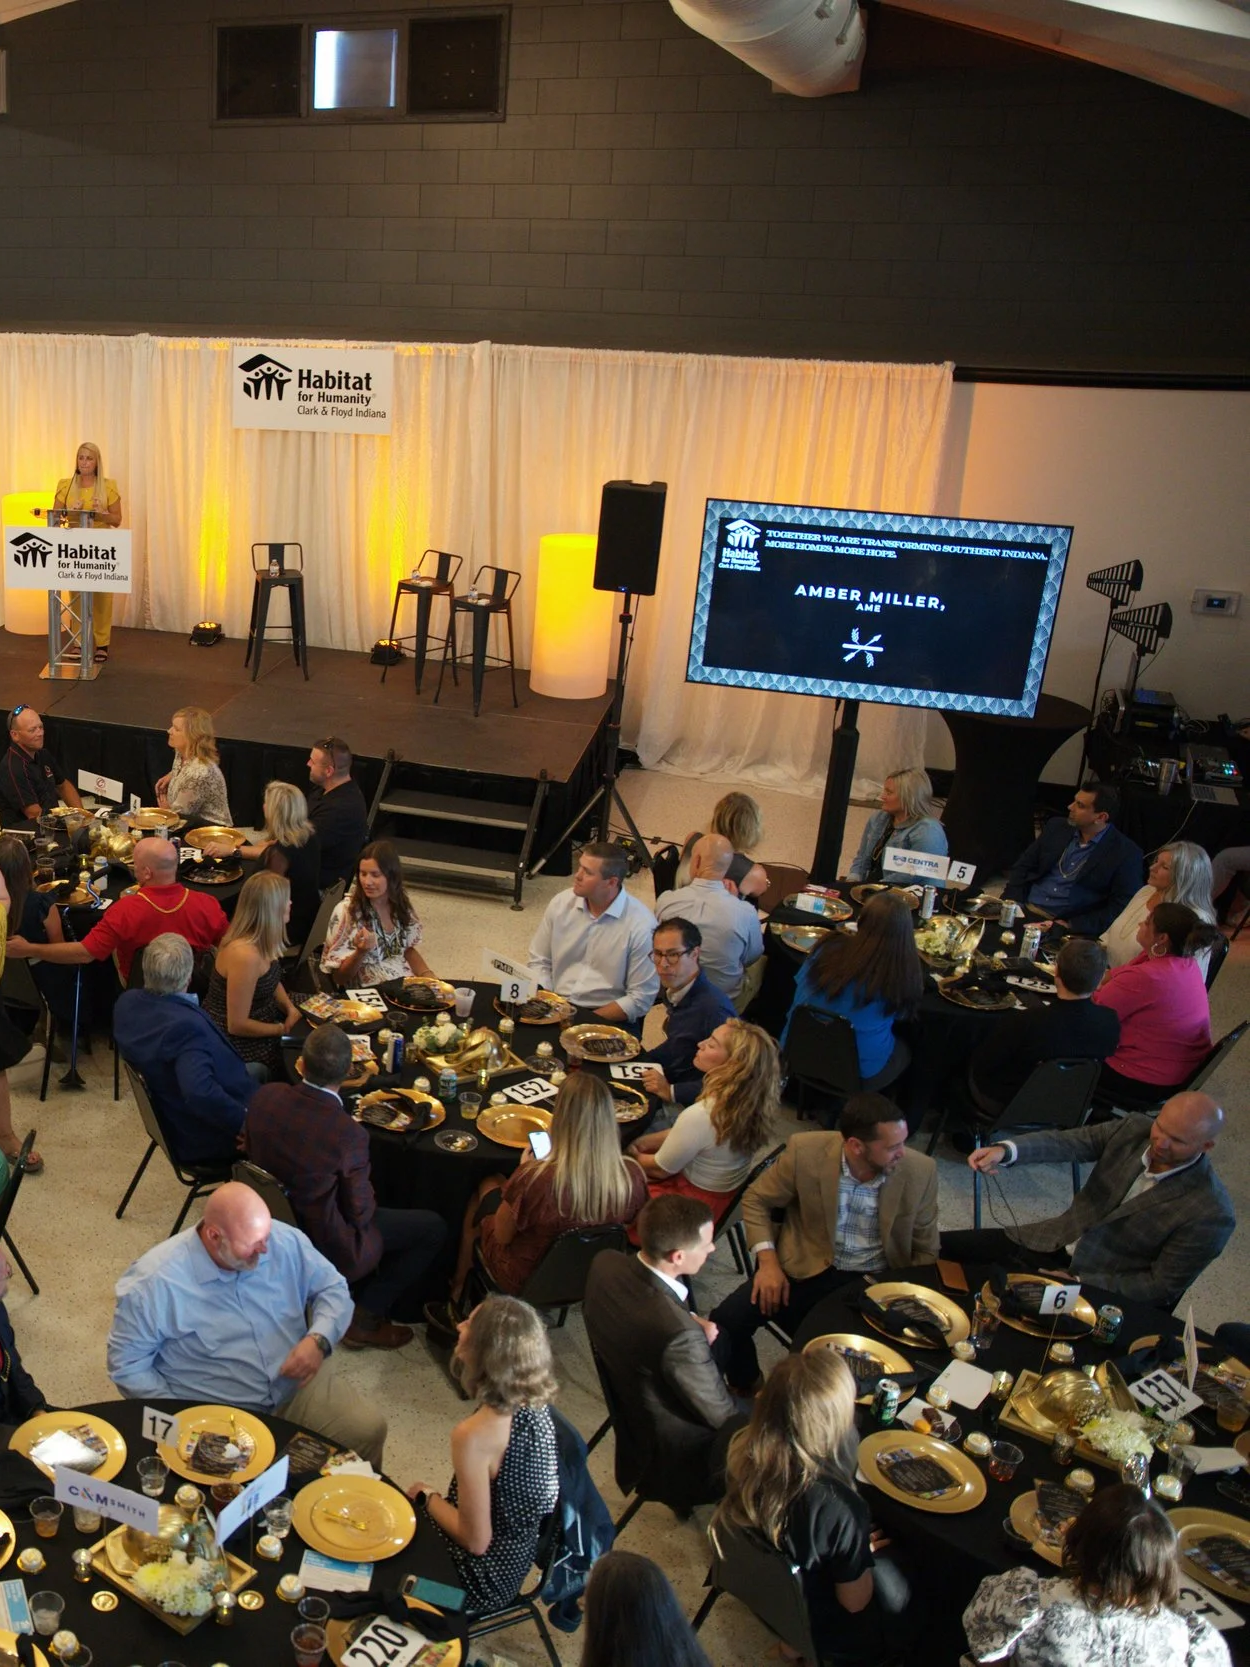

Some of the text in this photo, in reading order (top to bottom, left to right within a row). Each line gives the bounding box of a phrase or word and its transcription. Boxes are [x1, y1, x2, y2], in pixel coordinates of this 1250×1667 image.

[297, 368, 372, 391] Habitat
[297, 390, 314, 402] for
[297, 405, 387, 419] Clark & Floyd Indiana
[57, 543, 117, 560] Habitat
[722, 547, 759, 560] Habitat
[764, 540, 898, 559] MORE HOMES. MORE HOPE.
[766, 529, 1049, 561] TOGETHER WE ARE TRANSFORMING SOUTHERN INDIANA.
[57, 559, 71, 569] for
[57, 570, 76, 579] Clark
[84, 571, 102, 581] Floyd
[103, 573, 129, 581] Indiana
[794, 584, 946, 612] AMBER MILLER,
[855, 603, 882, 613] AME
[907, 858, 939, 869] CENTRA
[956, 865, 968, 879] 5
[510, 983, 520, 999] 8
[618, 1065, 653, 1078] 51
[511, 1080, 550, 1100] 152
[1053, 1290, 1068, 1310] 6
[1136, 1374, 1186, 1413] 137
[148, 1415, 174, 1441] 17
[110, 1500, 146, 1519] SMITH
[350, 1624, 408, 1667] 220
